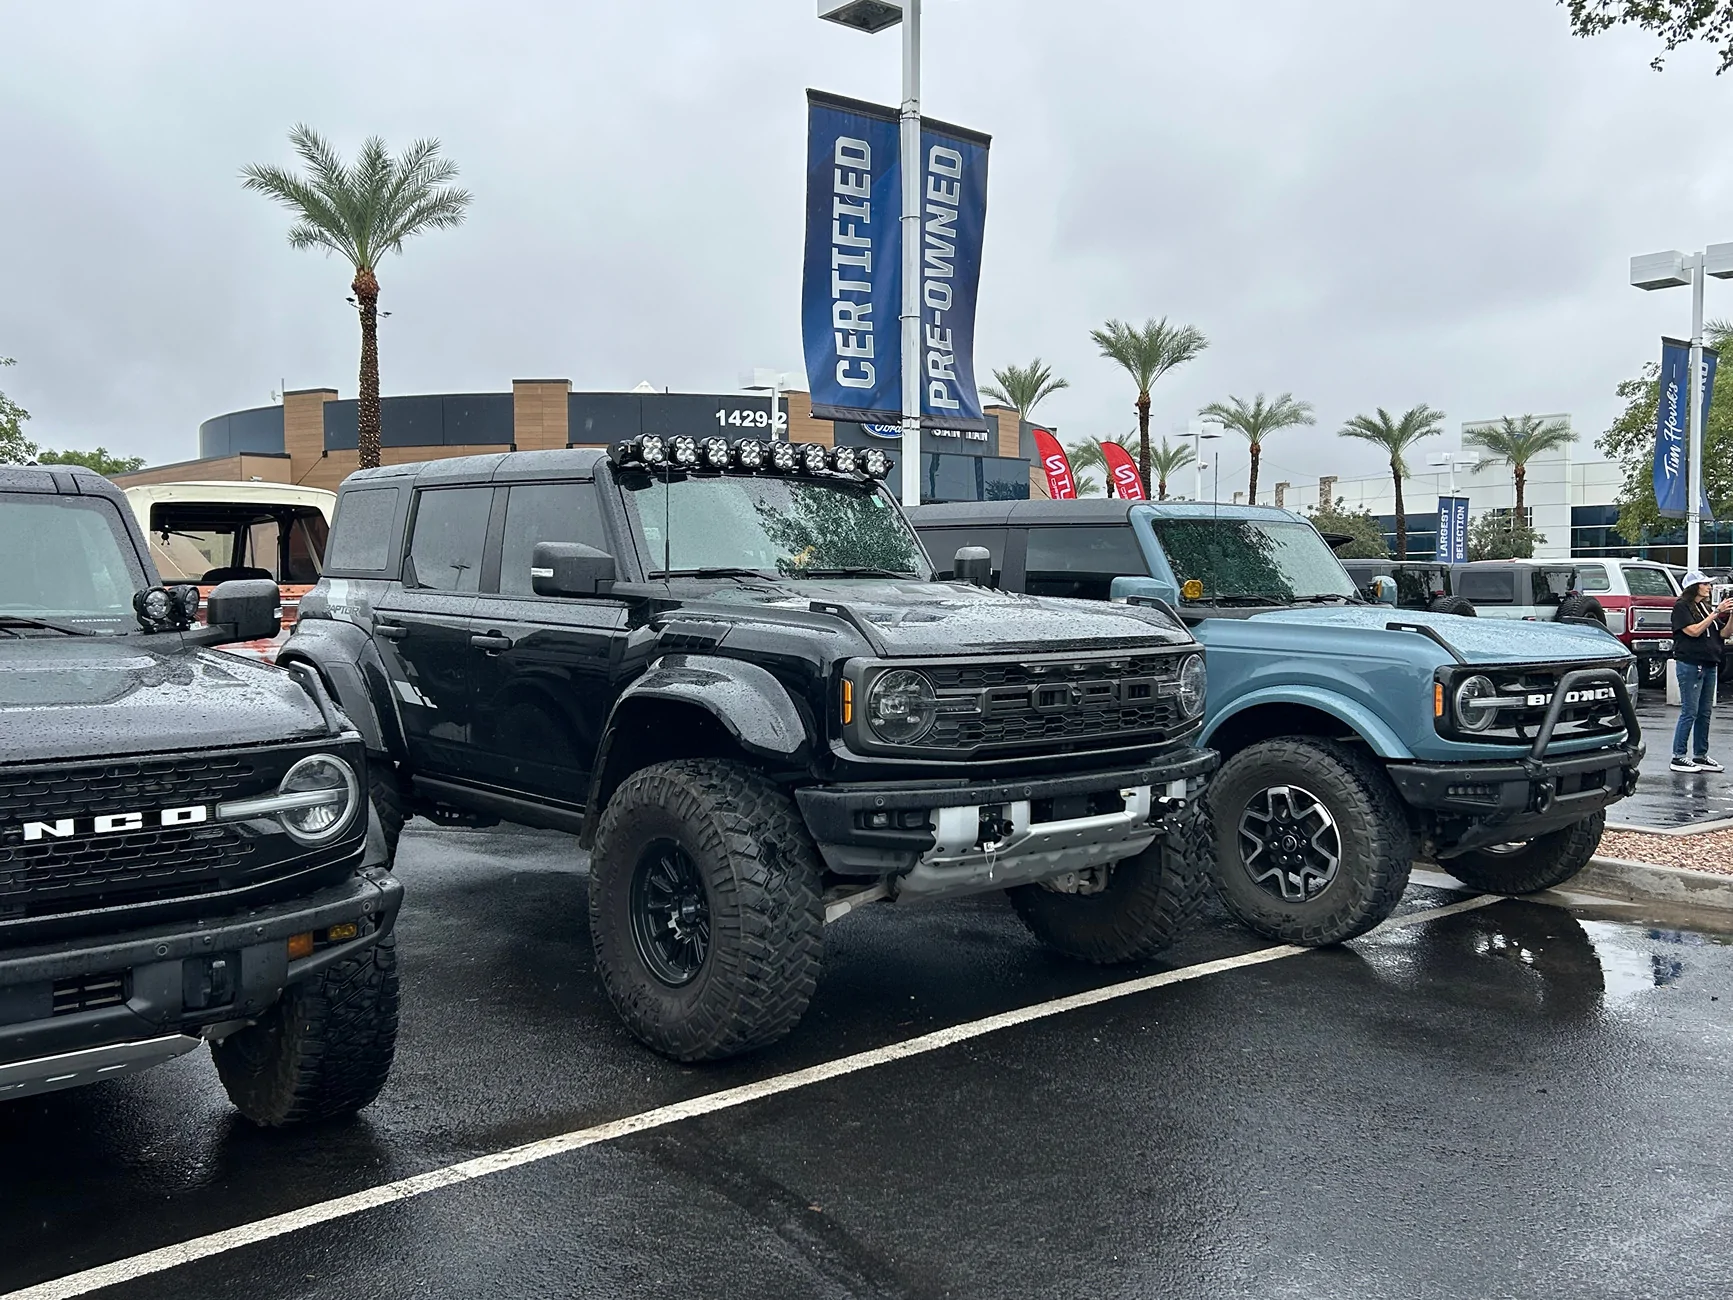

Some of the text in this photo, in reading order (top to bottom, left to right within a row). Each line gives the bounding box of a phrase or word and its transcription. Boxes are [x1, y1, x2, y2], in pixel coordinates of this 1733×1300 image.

[832, 136, 876, 389] CERTIFIED
[924, 144, 963, 409] PRE-OWNED
[1663, 381, 1682, 480] Tim Hovik's
[1440, 507, 1449, 557] LARGEST
[1455, 505, 1465, 560] SELECTION
[325, 604, 360, 617] RAPTOR
[981, 676, 1158, 718] FORD
[23, 805, 207, 841] NCO
